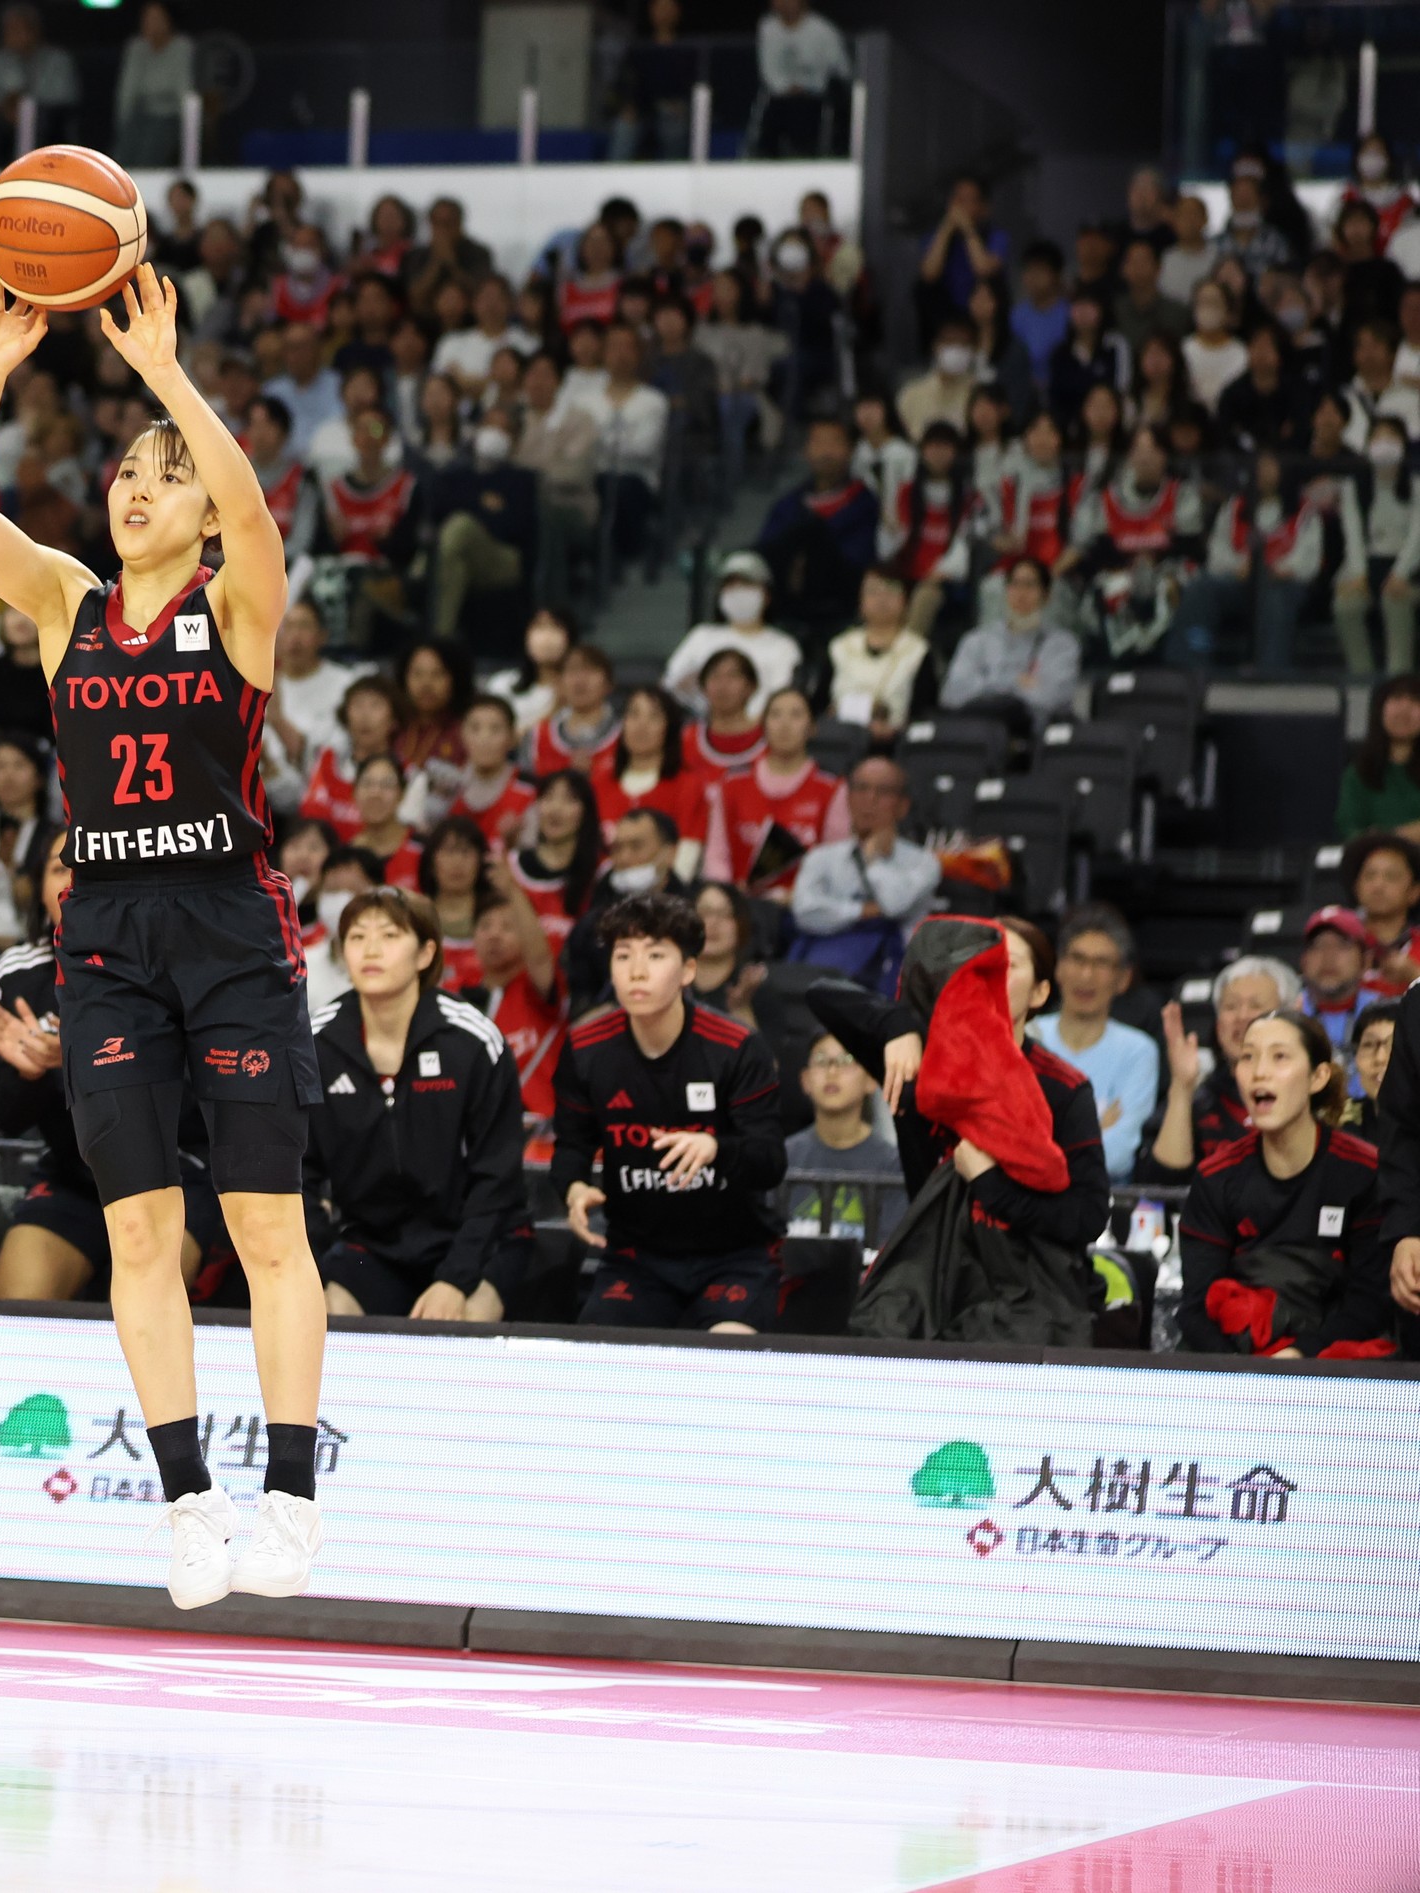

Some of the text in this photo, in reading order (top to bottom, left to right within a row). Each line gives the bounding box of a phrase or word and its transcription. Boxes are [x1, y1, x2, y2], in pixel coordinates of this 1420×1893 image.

[14, 261, 47, 278] FIBA
[183, 622, 201, 635] W
[66, 670, 223, 710] TOYOTA
[110, 733, 174, 806] 23
[93, 1052, 136, 1067] ANTELOPES
[1013, 1455, 1298, 1524] 大樹生命
